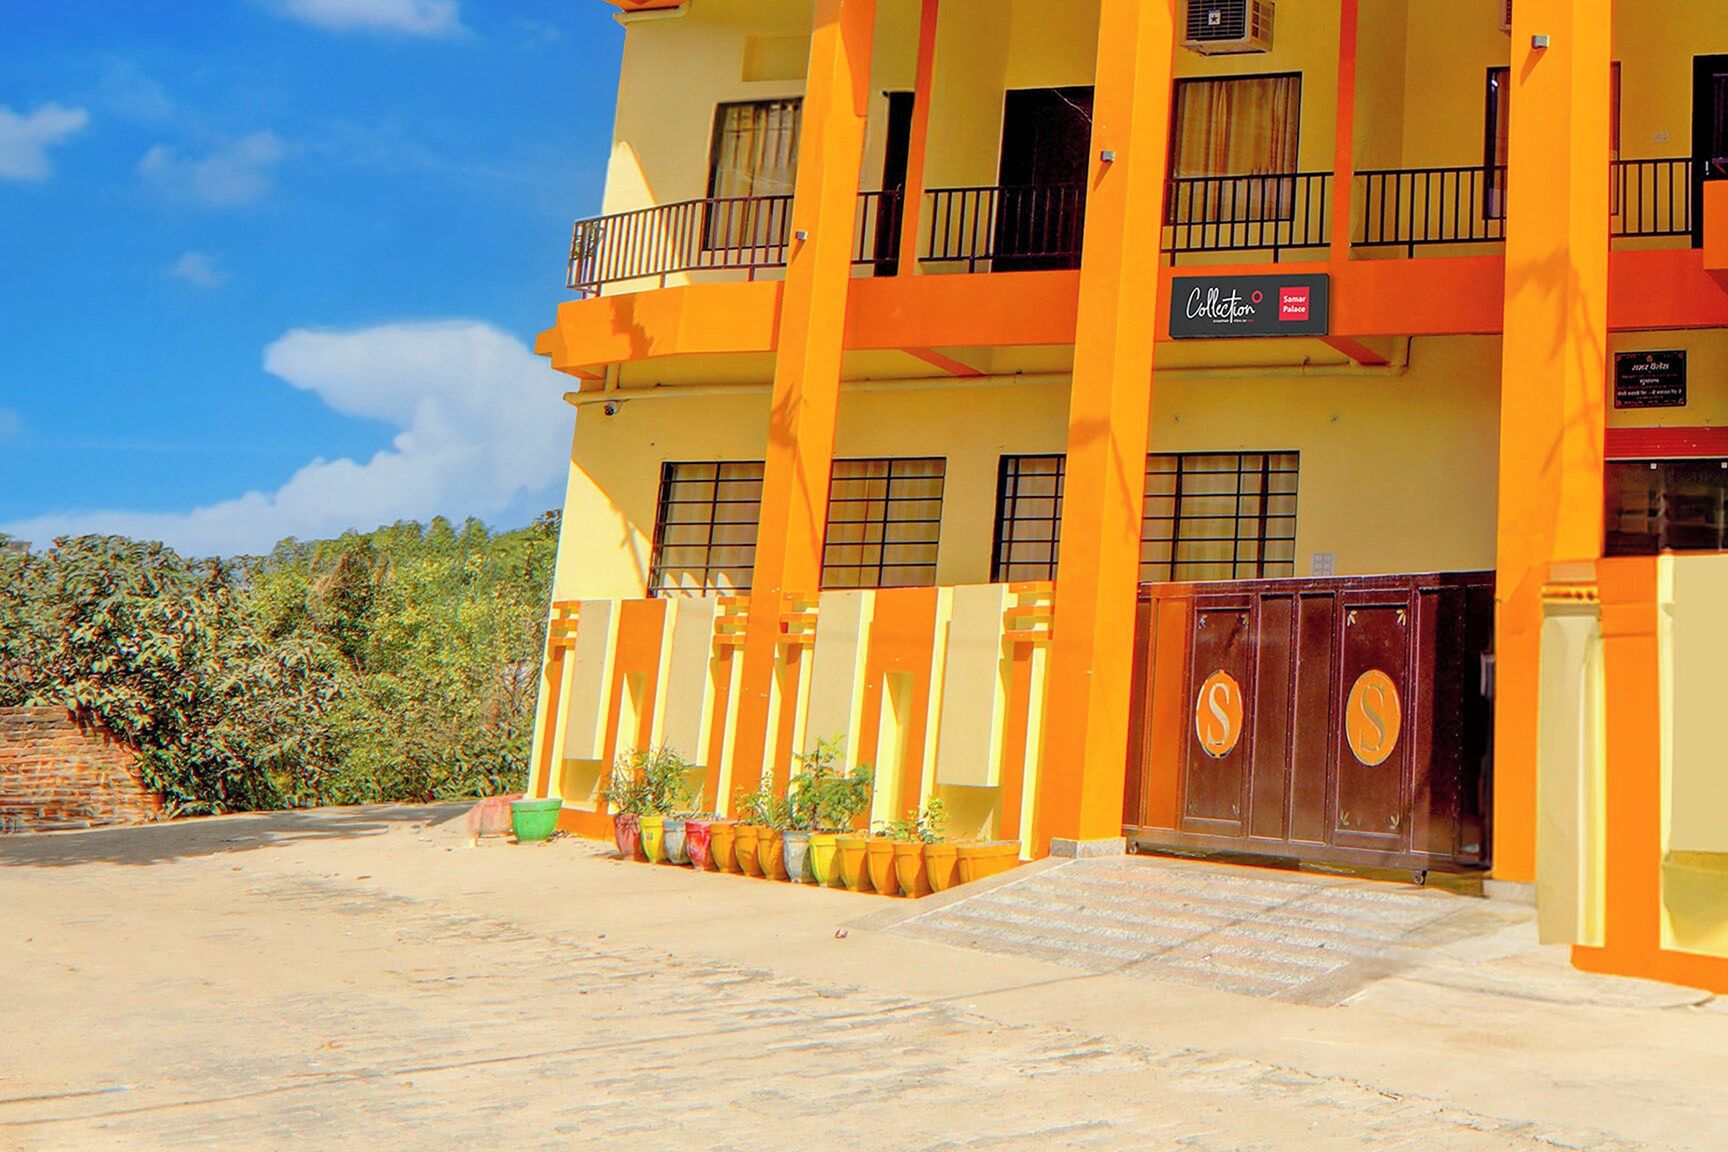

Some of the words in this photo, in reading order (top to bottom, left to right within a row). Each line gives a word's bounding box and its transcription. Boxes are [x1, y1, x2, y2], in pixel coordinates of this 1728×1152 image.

[1186, 287, 1255, 323] Collection
[1283, 295, 1306, 303] Samar
[1207, 682, 1230, 745] S
[1359, 683, 1386, 753] S
